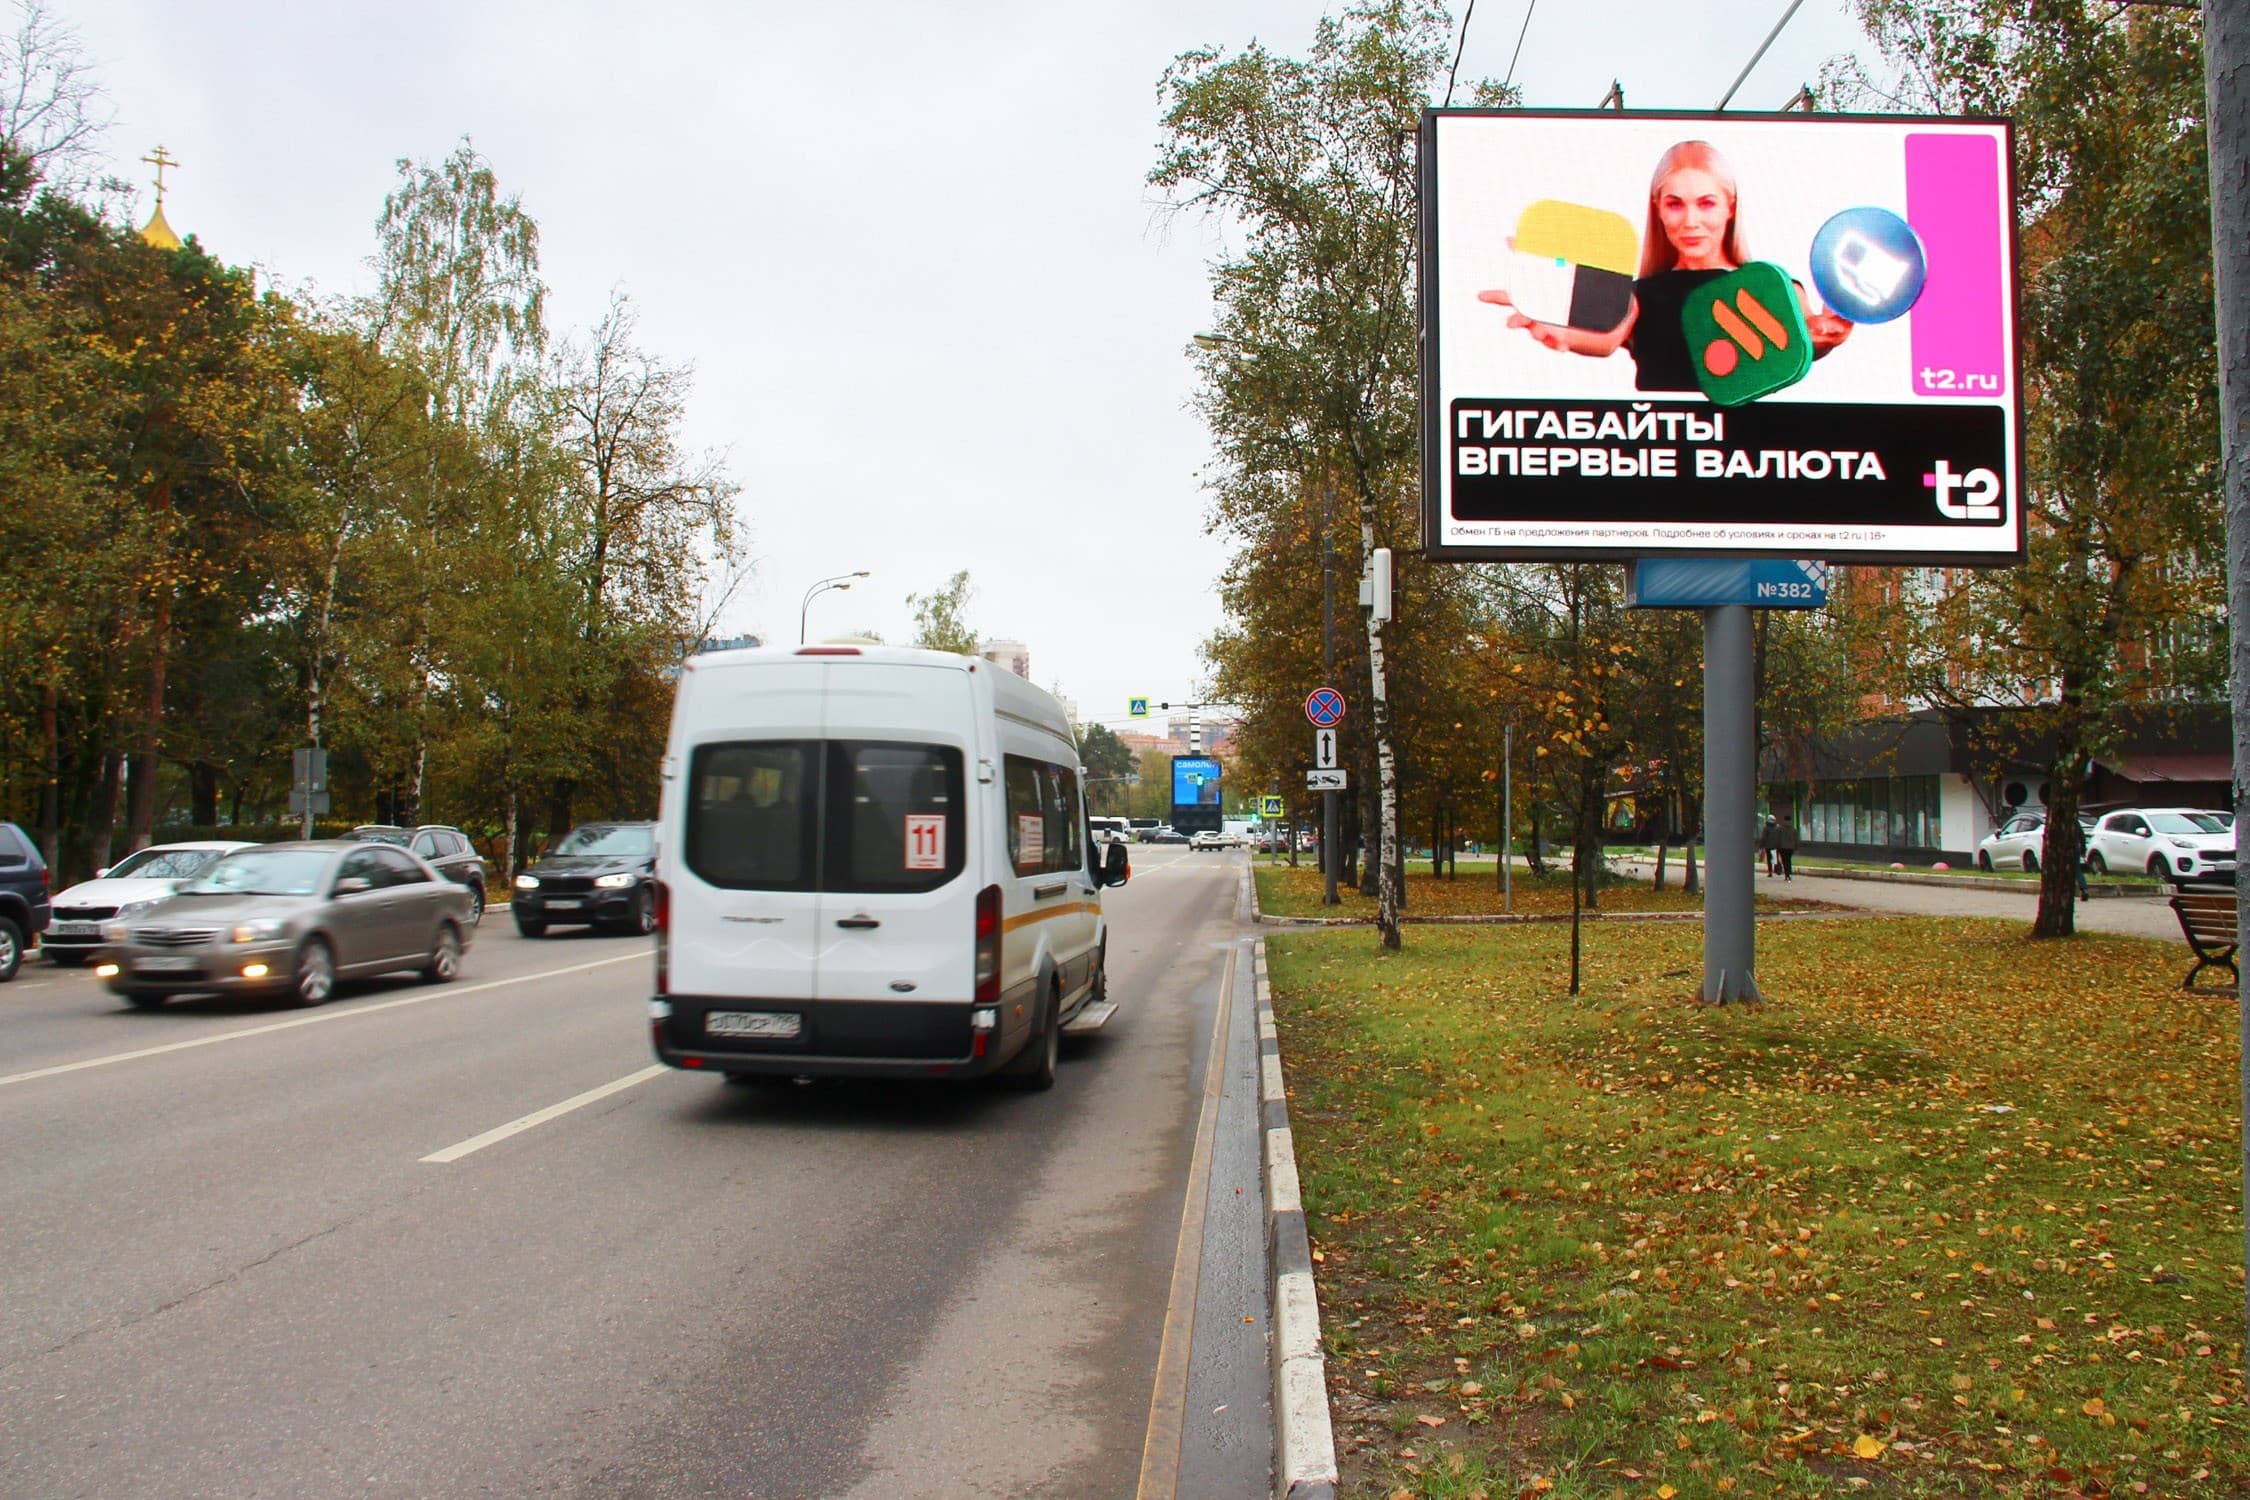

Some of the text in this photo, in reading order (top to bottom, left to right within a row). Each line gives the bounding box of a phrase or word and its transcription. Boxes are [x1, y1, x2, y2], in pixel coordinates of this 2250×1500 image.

[1920, 367, 1998, 390] t2.ru
[1458, 402, 1723, 441] ГИГАБАЙТЫ
[1458, 446, 1886, 480] ВПЕРВЫЕ ВАЛЮТА
[1923, 460, 2000, 519] t2
[1450, 526, 1486, 537] Обмен
[1489, 528, 1501, 537] ГБ
[1504, 529, 1516, 537] на
[1519, 528, 1590, 539] предложения
[1652, 529, 1711, 540] Подробнее
[1713, 529, 1726, 539] об
[1728, 531, 1776, 540] условиях
[1786, 531, 1822, 541] сроках
[1824, 532, 1837, 540] на
[1838, 530, 1863, 541] t2ru
[1757, 582, 1812, 598] №382
[1176, 761, 1216, 769] самол
[911, 824, 937, 855] 11
